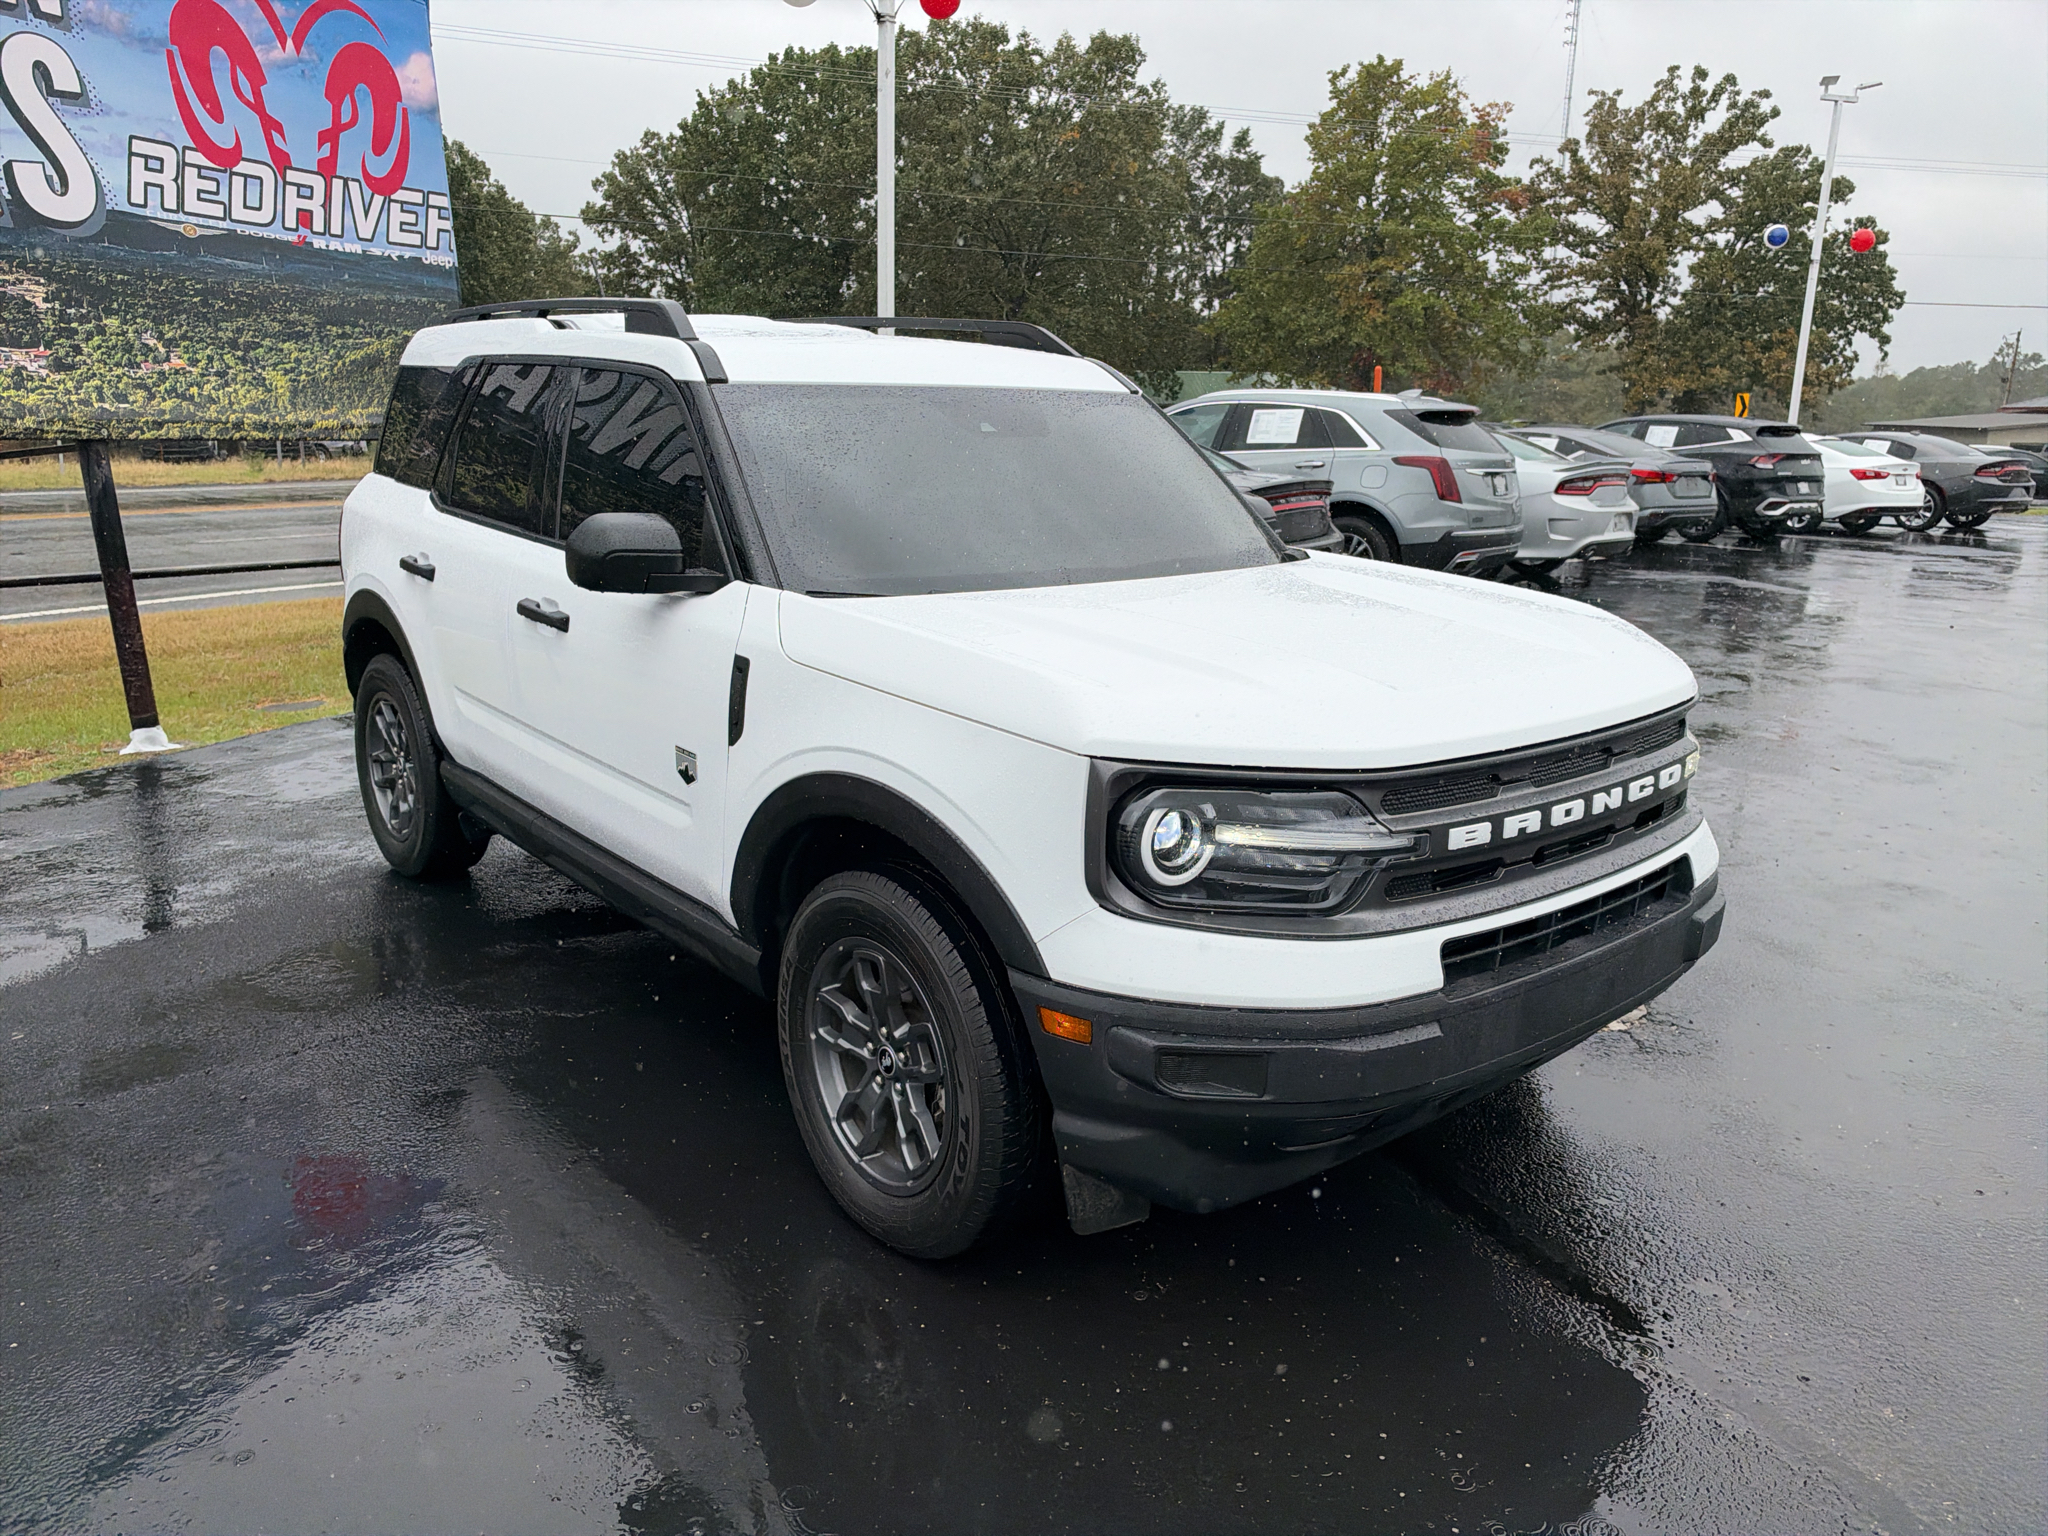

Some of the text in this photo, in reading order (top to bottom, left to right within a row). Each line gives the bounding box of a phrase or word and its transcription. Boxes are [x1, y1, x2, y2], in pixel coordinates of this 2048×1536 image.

[237, 228, 300, 243] DODGE
[312, 238, 362, 254] RAM
[365, 247, 416, 261] SRT
[422, 251, 453, 270] Jeep
[1448, 764, 1682, 851] BRONCO
